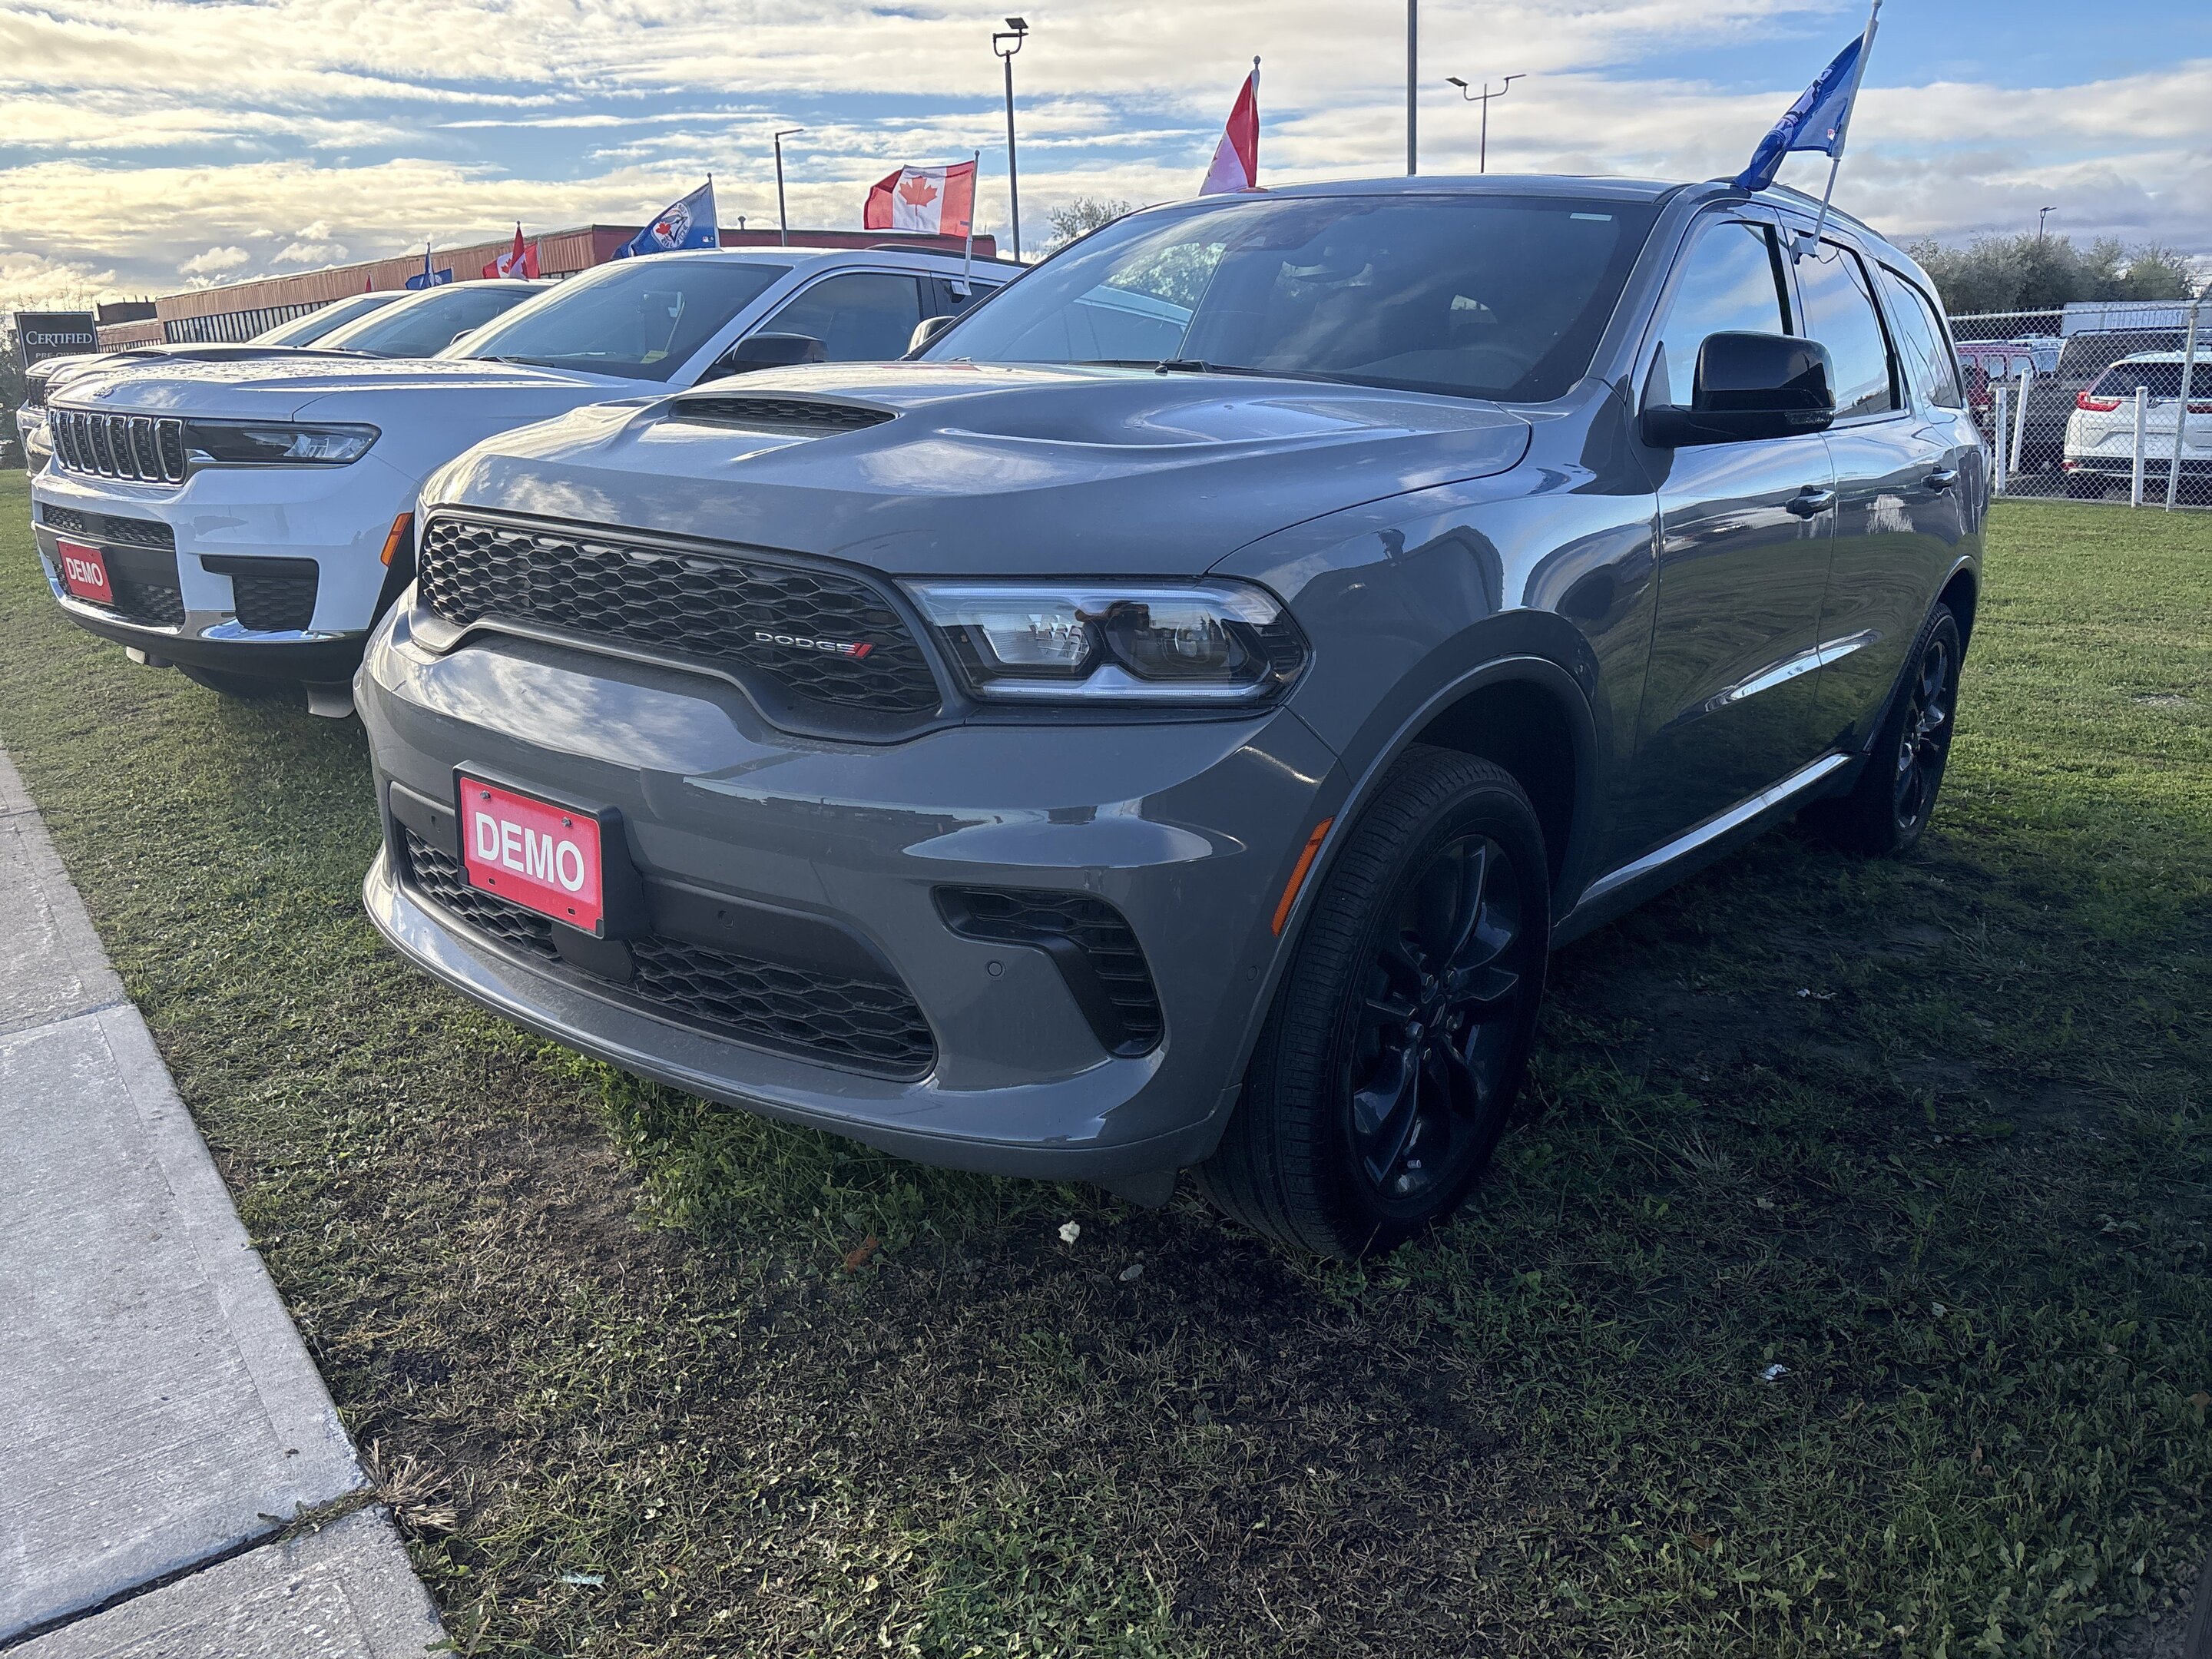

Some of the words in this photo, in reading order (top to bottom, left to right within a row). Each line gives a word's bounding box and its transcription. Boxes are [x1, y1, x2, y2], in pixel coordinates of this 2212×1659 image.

[25, 330, 93, 347] CERTIFIED
[65, 557, 104, 587] DEMO
[754, 631, 856, 654] DODGE
[475, 811, 584, 892] DEMO
